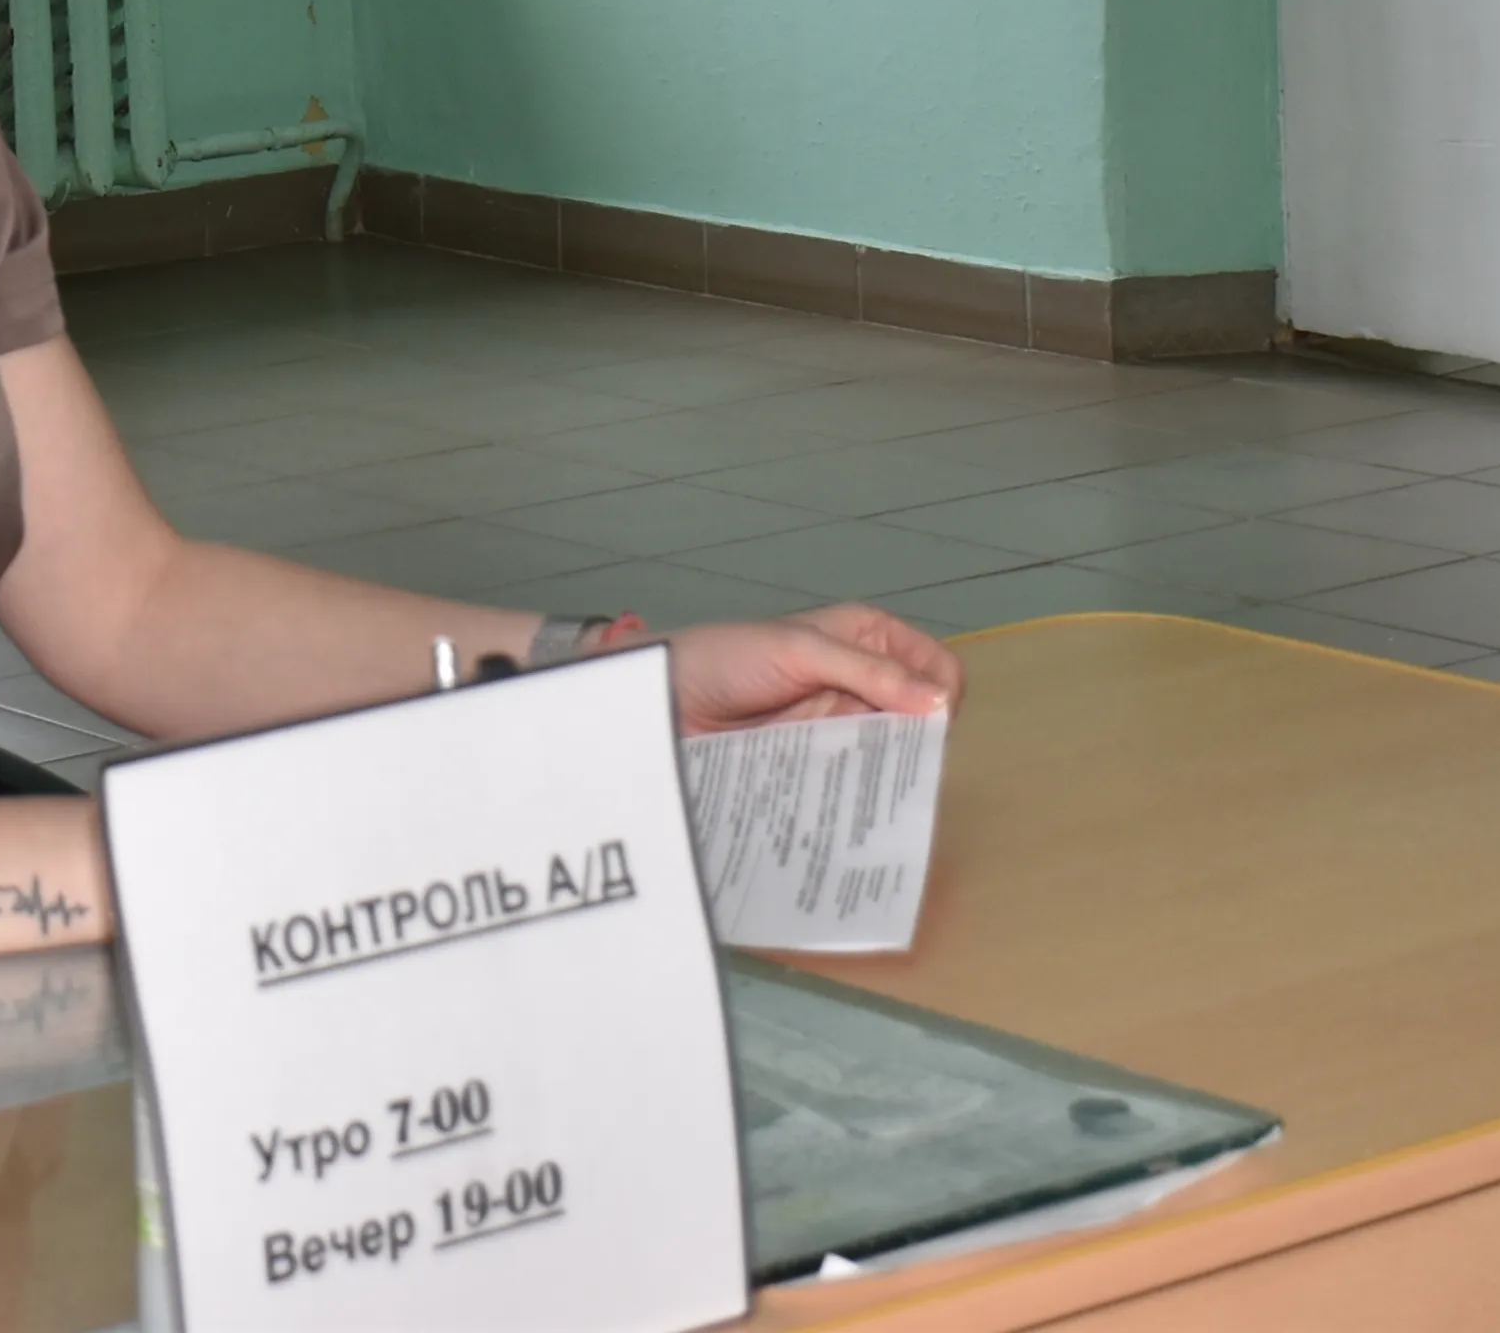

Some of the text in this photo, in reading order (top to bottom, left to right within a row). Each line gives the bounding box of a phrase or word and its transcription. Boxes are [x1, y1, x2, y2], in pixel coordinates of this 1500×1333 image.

[249, 838, 638, 975] КОНТРОЛЬ А/Д
[250, 1077, 491, 1183] Утро 7-00
[262, 1159, 564, 1285] Вечер 19-00
